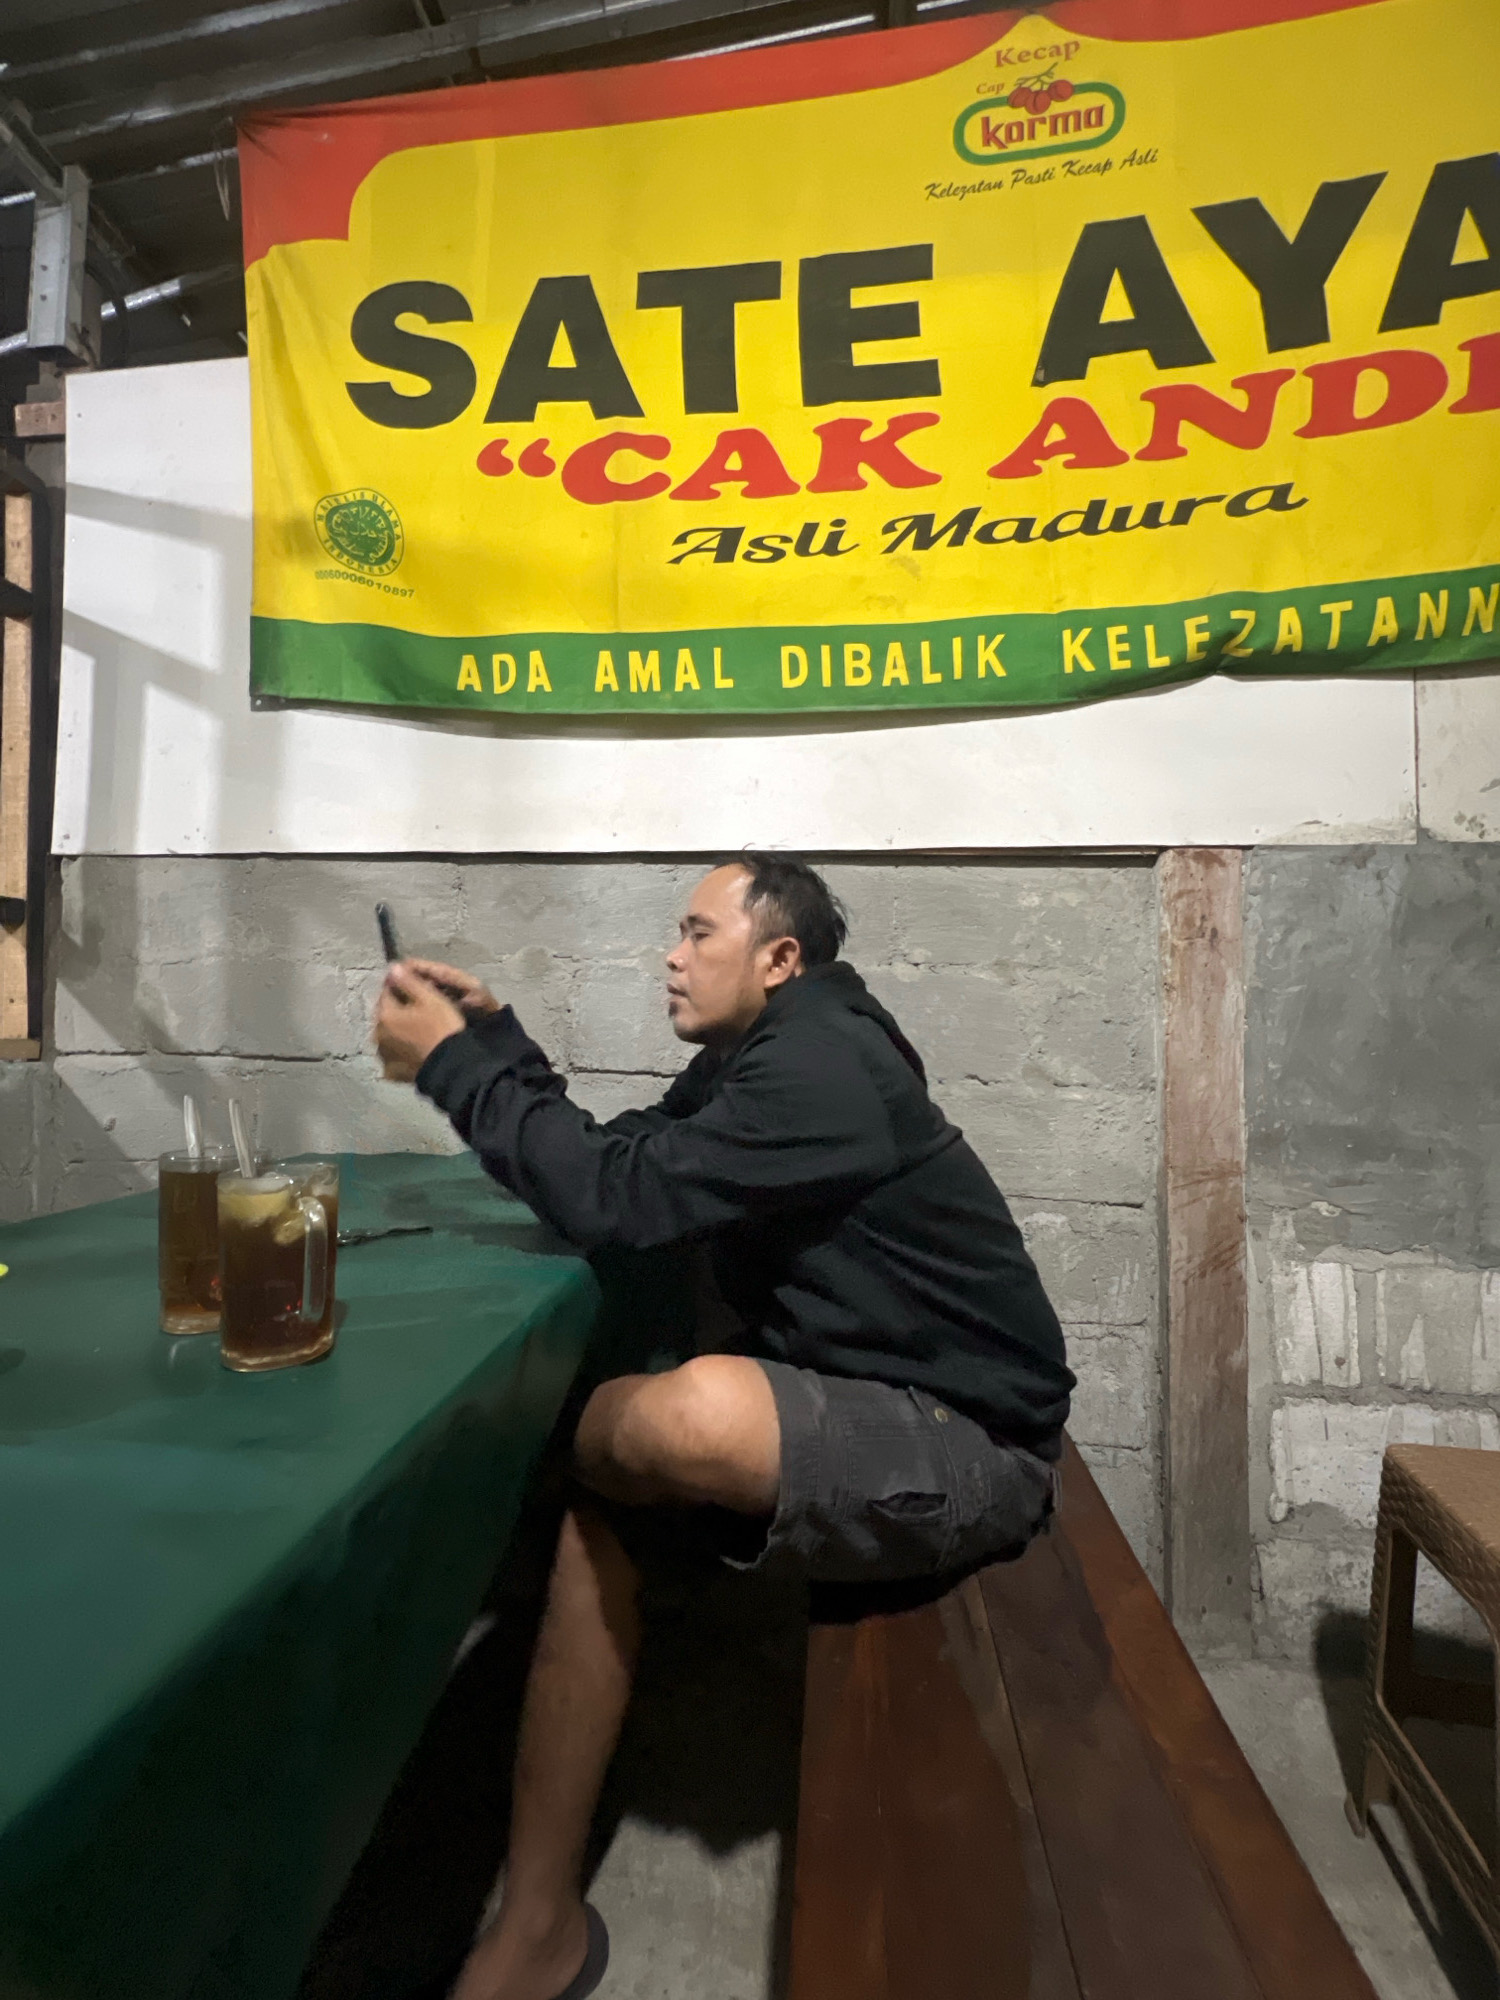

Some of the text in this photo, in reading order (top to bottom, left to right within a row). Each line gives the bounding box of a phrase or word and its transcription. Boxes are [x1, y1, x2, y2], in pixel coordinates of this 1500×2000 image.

[995, 40, 1081, 68] Kecap
[976, 81, 1005, 96] Cap
[981, 103, 1106, 150] korma
[924, 148, 1159, 201] Kelezatan Pasti Kecap Asli
[345, 152, 1500, 429] SATE AYA
[666, 481, 1310, 565] Asli Madura
[323, 538, 398, 574] INDONESIA
[456, 583, 1500, 694] ADA AMAL DIBALIK KELEZATANN
